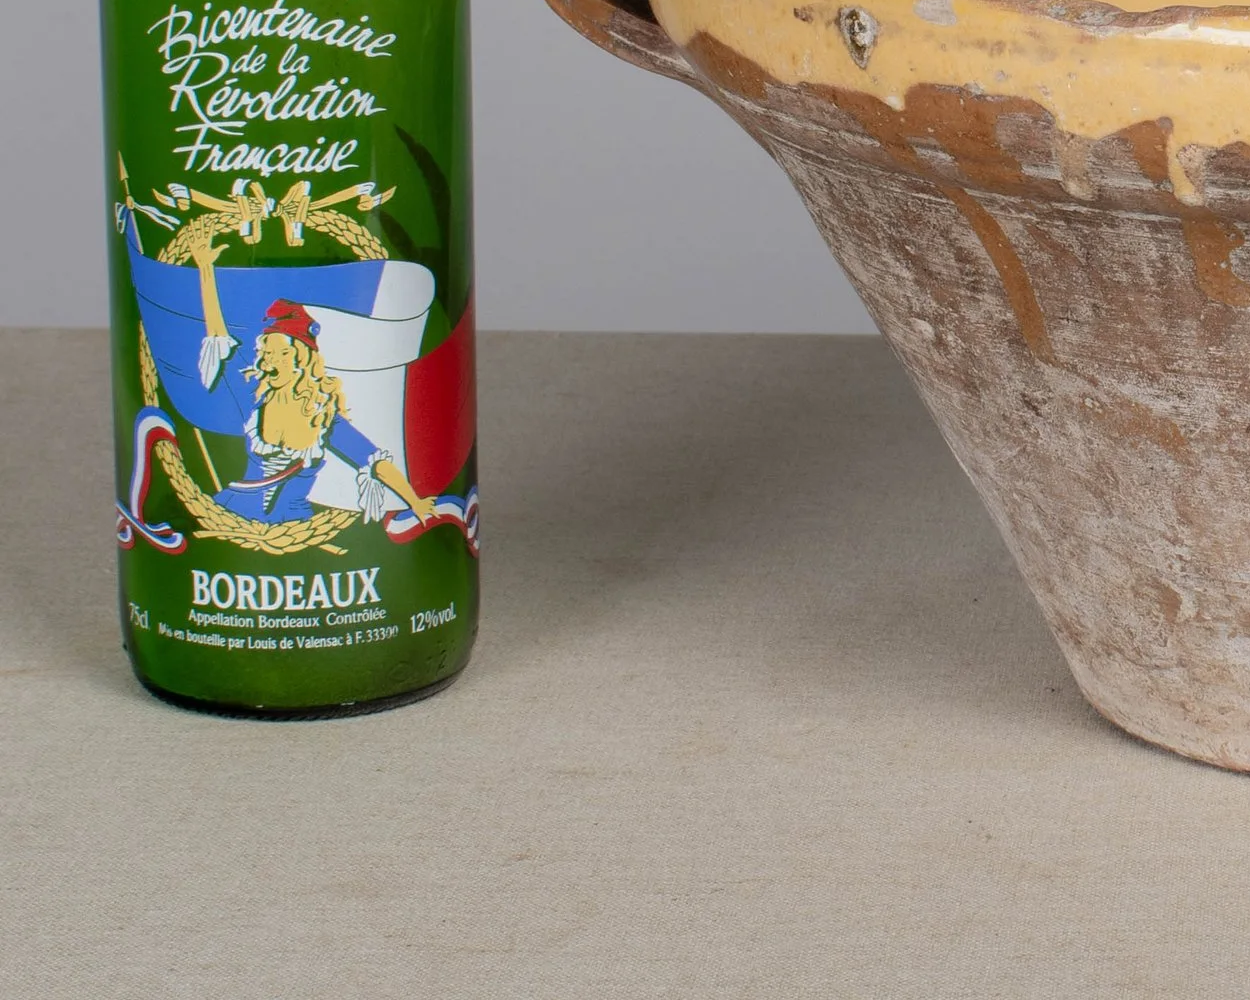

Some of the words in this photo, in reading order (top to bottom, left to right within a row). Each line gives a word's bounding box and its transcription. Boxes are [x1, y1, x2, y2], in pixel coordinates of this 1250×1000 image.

[231, 45, 266, 74] de
[278, 43, 310, 75] la
[162, 52, 387, 135] Révolution
[172, 121, 359, 177] Française
[191, 567, 382, 612] BORDEAUX
[158, 622, 174, 638] Mis
[174, 629, 185, 641] en
[186, 629, 226, 647] bouteille
[228, 637, 245, 651] par
[248, 636, 277, 650] Louis
[280, 637, 293, 650] de
[296, 635, 343, 649] Valensac
[346, 632, 353, 646] à
[188, 608, 254, 629] Appellation
[258, 614, 320, 629] Bordeaux
[326, 607, 387, 626] Contrôlée
